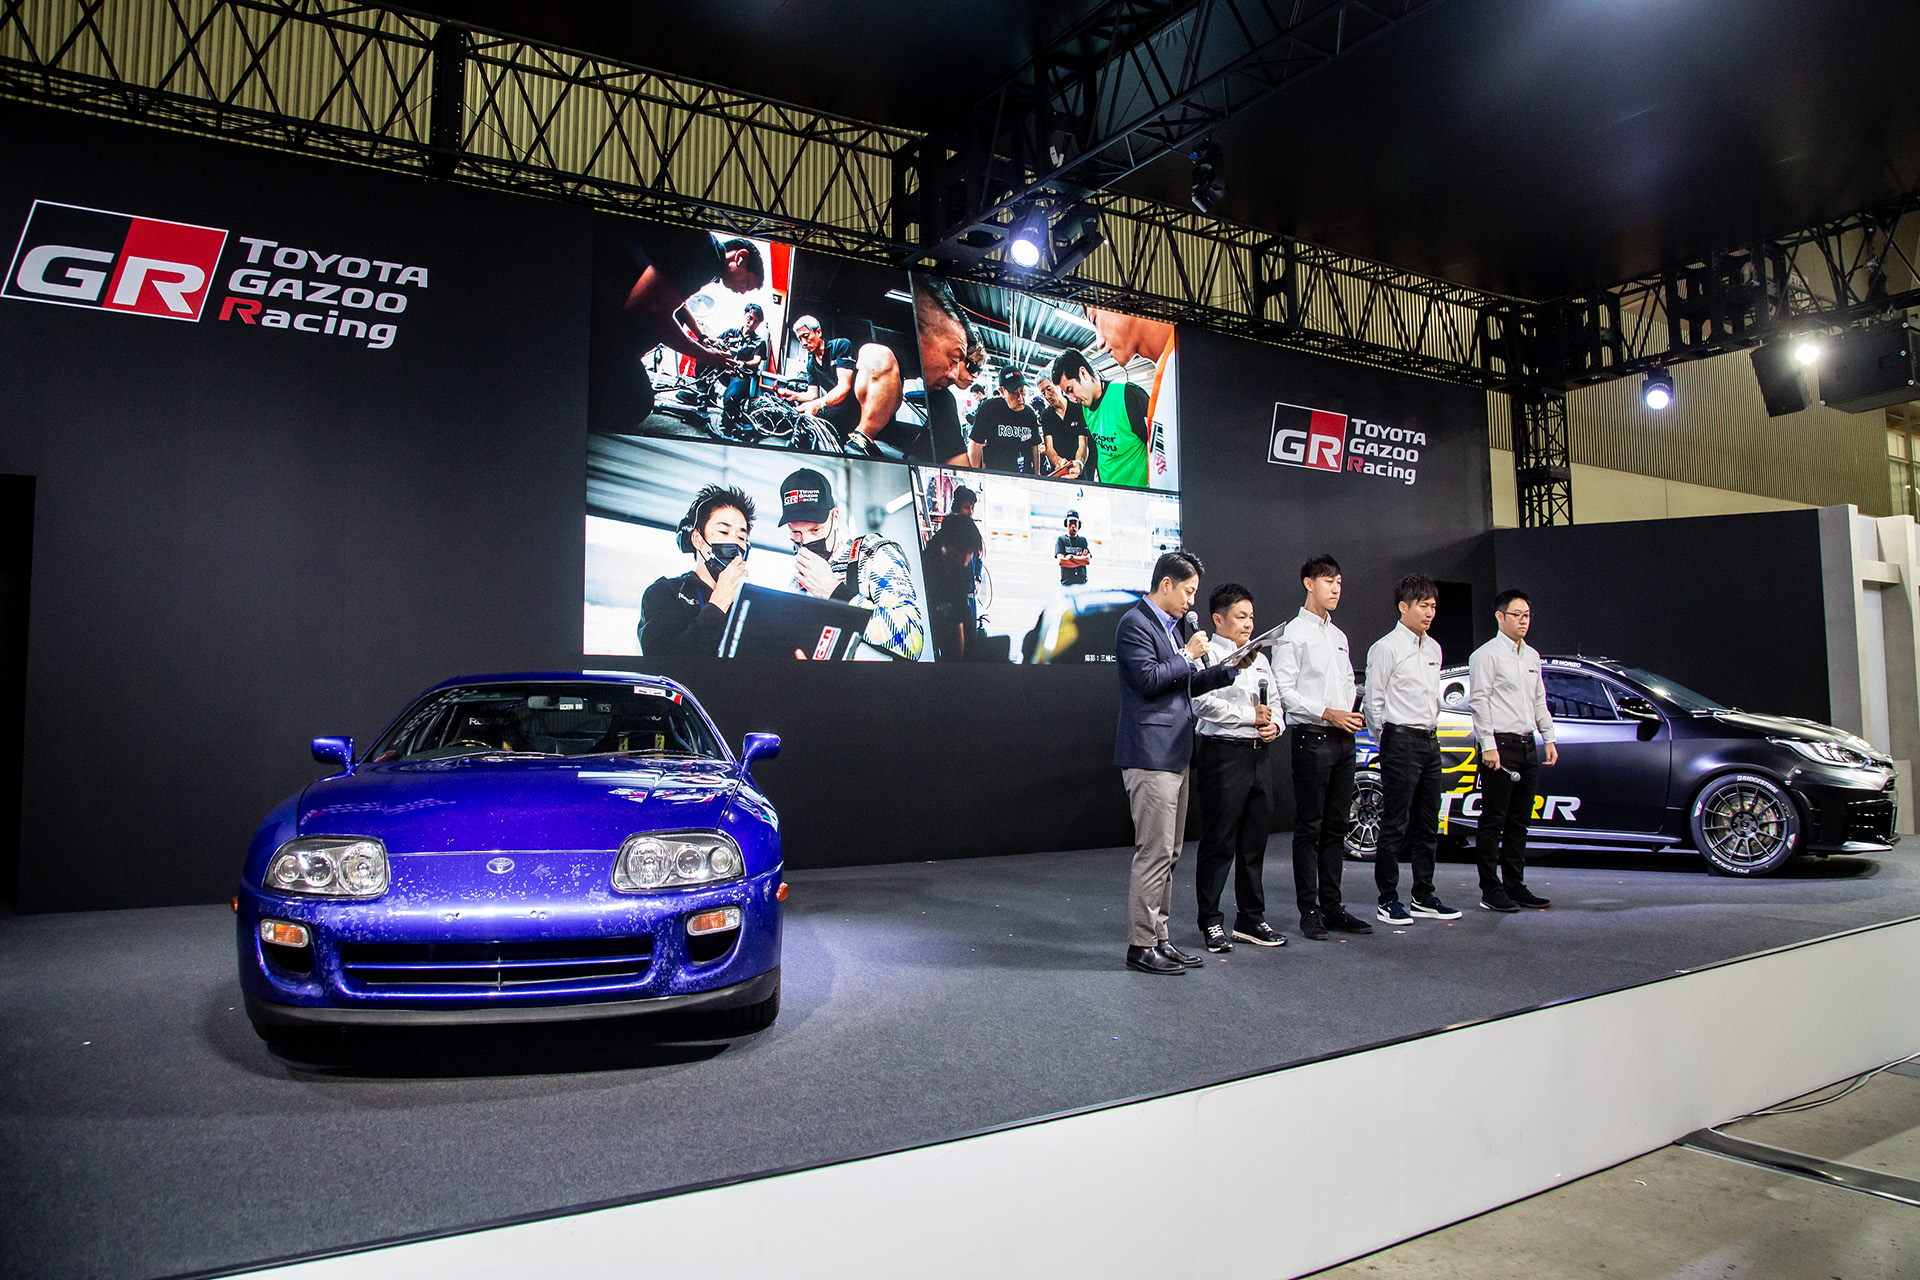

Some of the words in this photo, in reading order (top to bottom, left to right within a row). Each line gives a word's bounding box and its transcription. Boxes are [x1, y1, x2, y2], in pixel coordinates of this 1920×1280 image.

[17, 244, 206, 314] GR
[239, 236, 429, 288] TOYOTA
[228, 268, 408, 313] GAZOO
[218, 296, 398, 349] Racing
[1273, 429, 1341, 468] GR
[1349, 437, 1420, 463] GAZOO
[1351, 418, 1427, 446] TOYOTA
[1347, 455, 1417, 485] Racing
